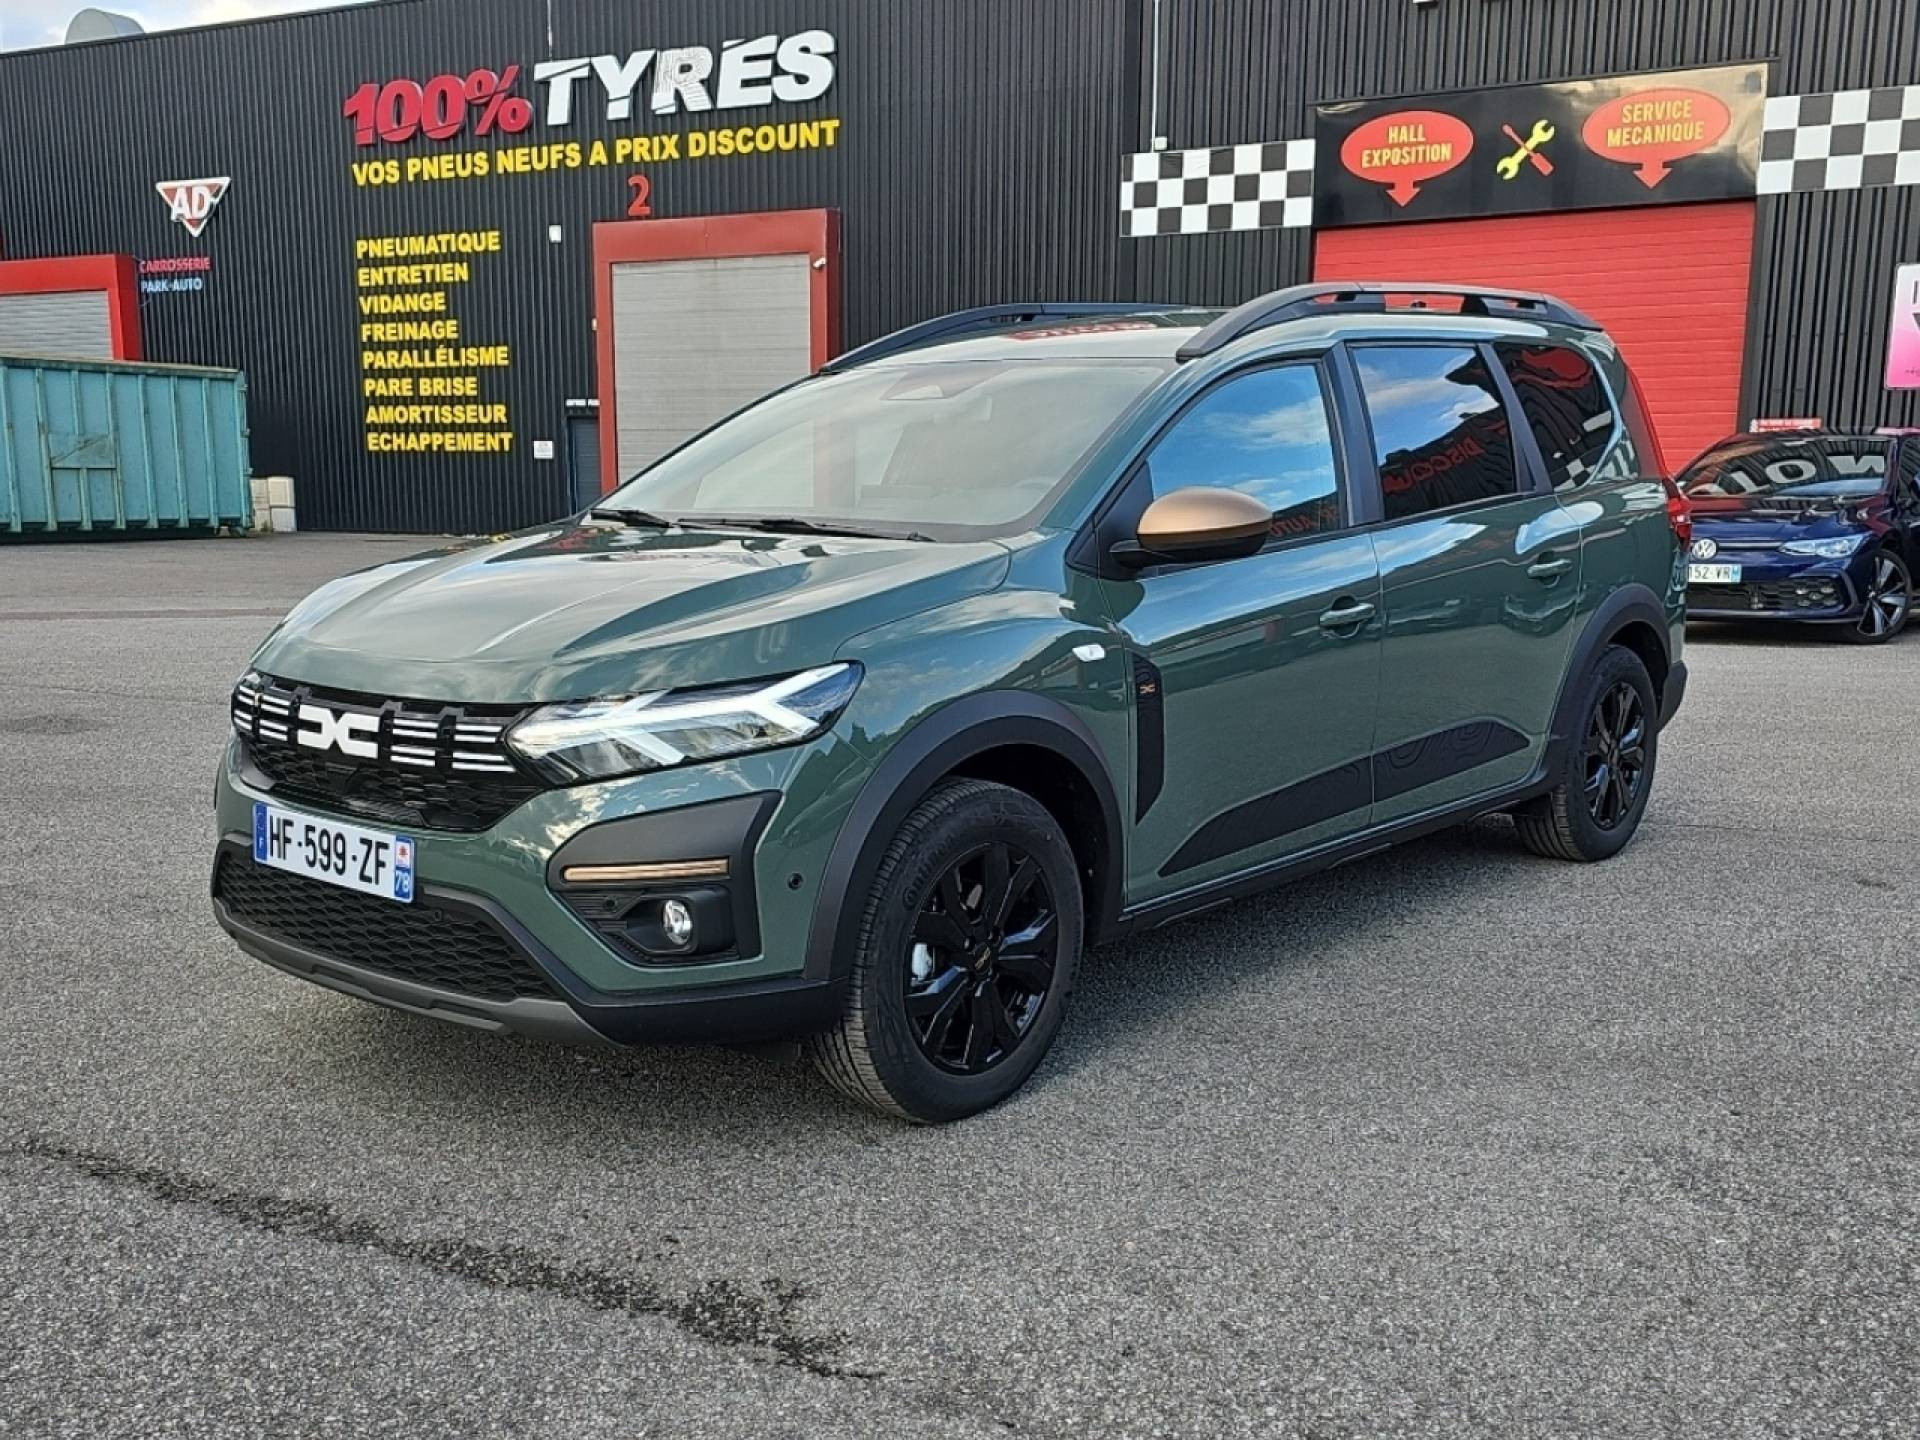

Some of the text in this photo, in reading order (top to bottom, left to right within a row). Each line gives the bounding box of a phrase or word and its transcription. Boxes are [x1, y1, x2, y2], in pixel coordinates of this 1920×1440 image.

[343, 65, 534, 145] 100%
[1622, 99, 1692, 124] SERVICE
[1388, 123, 1426, 144] HALL
[1607, 121, 1704, 148] MECANIQUE
[352, 119, 840, 186] VOS PNEUS NEUFS A PRIX DISCOUNT
[1361, 143, 1453, 169] EXPOSITION
[171, 185, 211, 220] AD
[627, 174, 651, 217] 2
[356, 230, 501, 259] PNEUMATIQUE
[357, 262, 469, 287] ENTRETIEN
[359, 291, 447, 315] VIDANGE
[361, 320, 459, 342] FREINAGE
[362, 345, 510, 369] PARALLÉLISME
[364, 377, 478, 397] PARE BRISE
[366, 404, 507, 424] AMORTISSEUR
[367, 431, 513, 451] ECHAPPEMENT
[395, 870, 411, 893] 78
